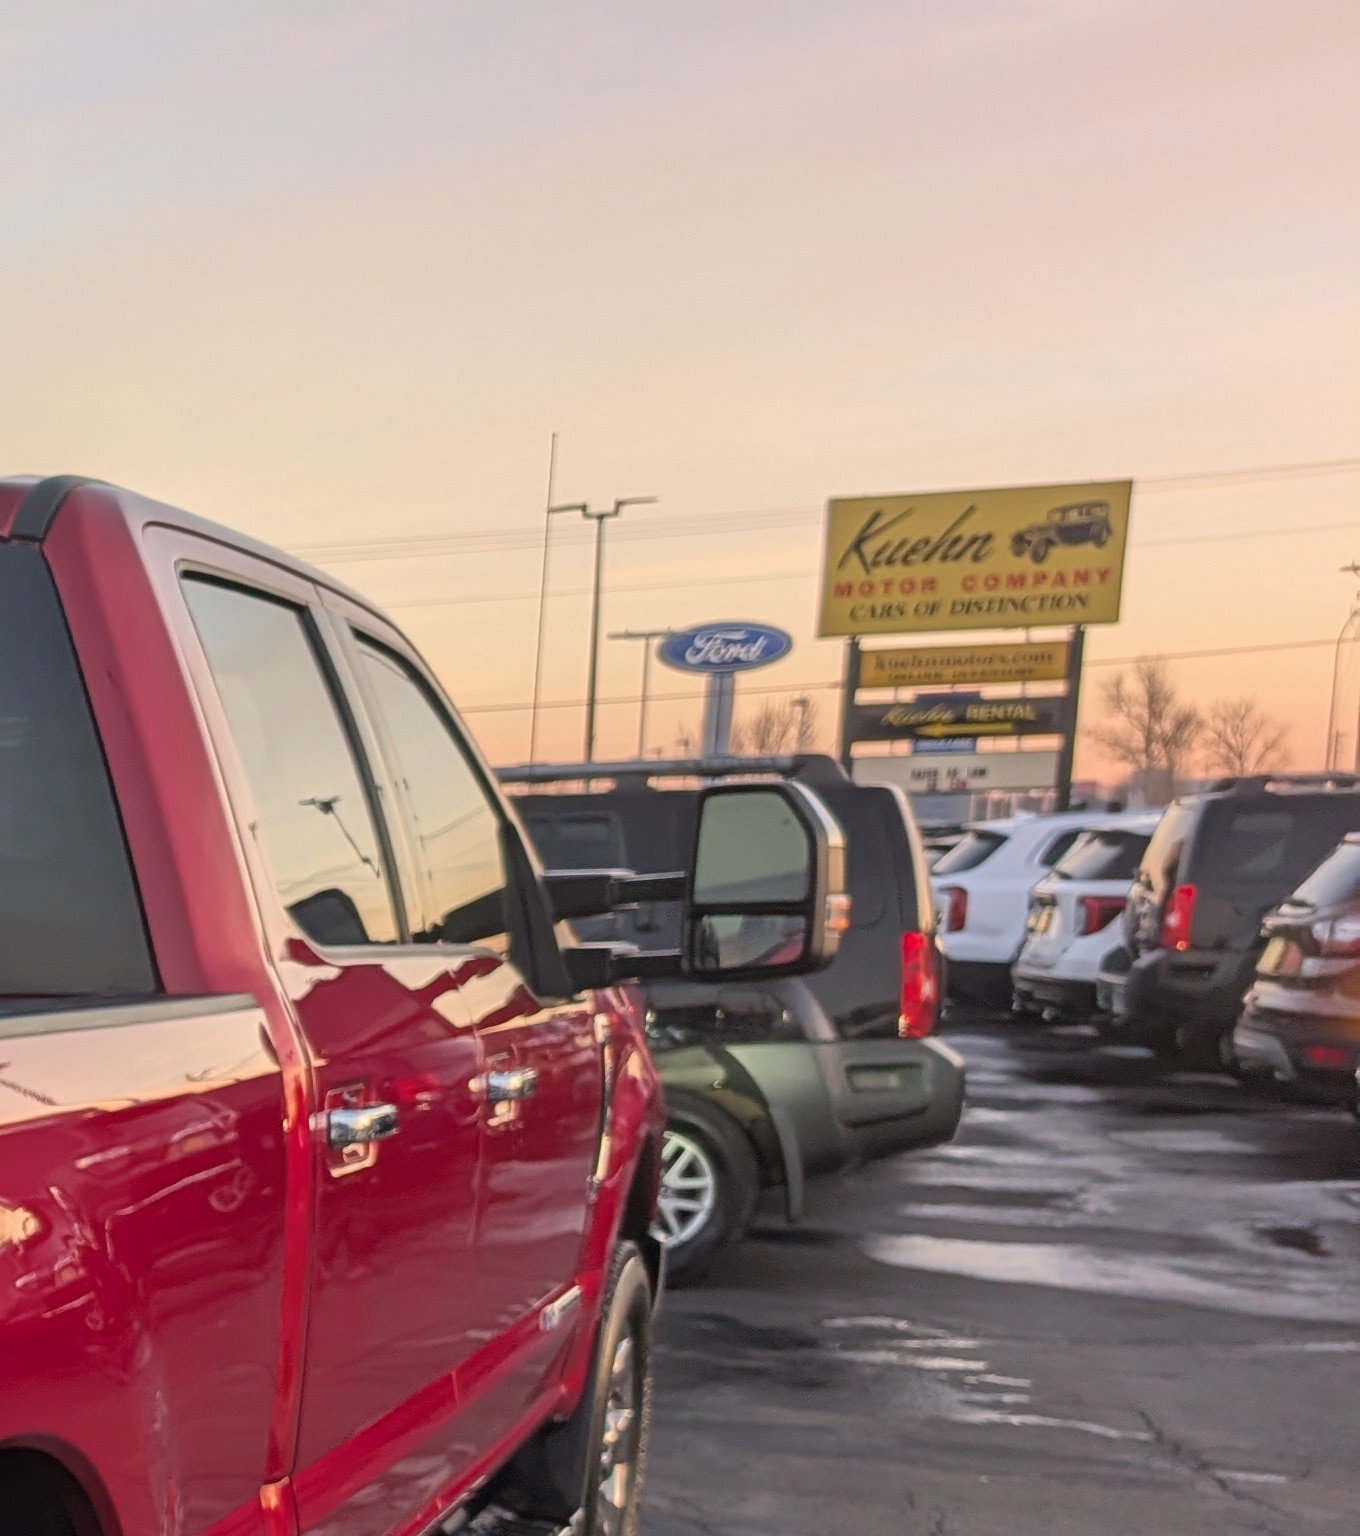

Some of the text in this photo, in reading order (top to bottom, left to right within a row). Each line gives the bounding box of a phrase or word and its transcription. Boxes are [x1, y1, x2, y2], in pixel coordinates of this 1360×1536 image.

[836, 504, 994, 575] Kuehn
[834, 568, 1111, 600] MOTOR COMPANY
[849, 593, 1089, 623] CARS OF DISTINCTION
[684, 629, 769, 665] Ford
[966, 702, 1036, 721] RENTAL
